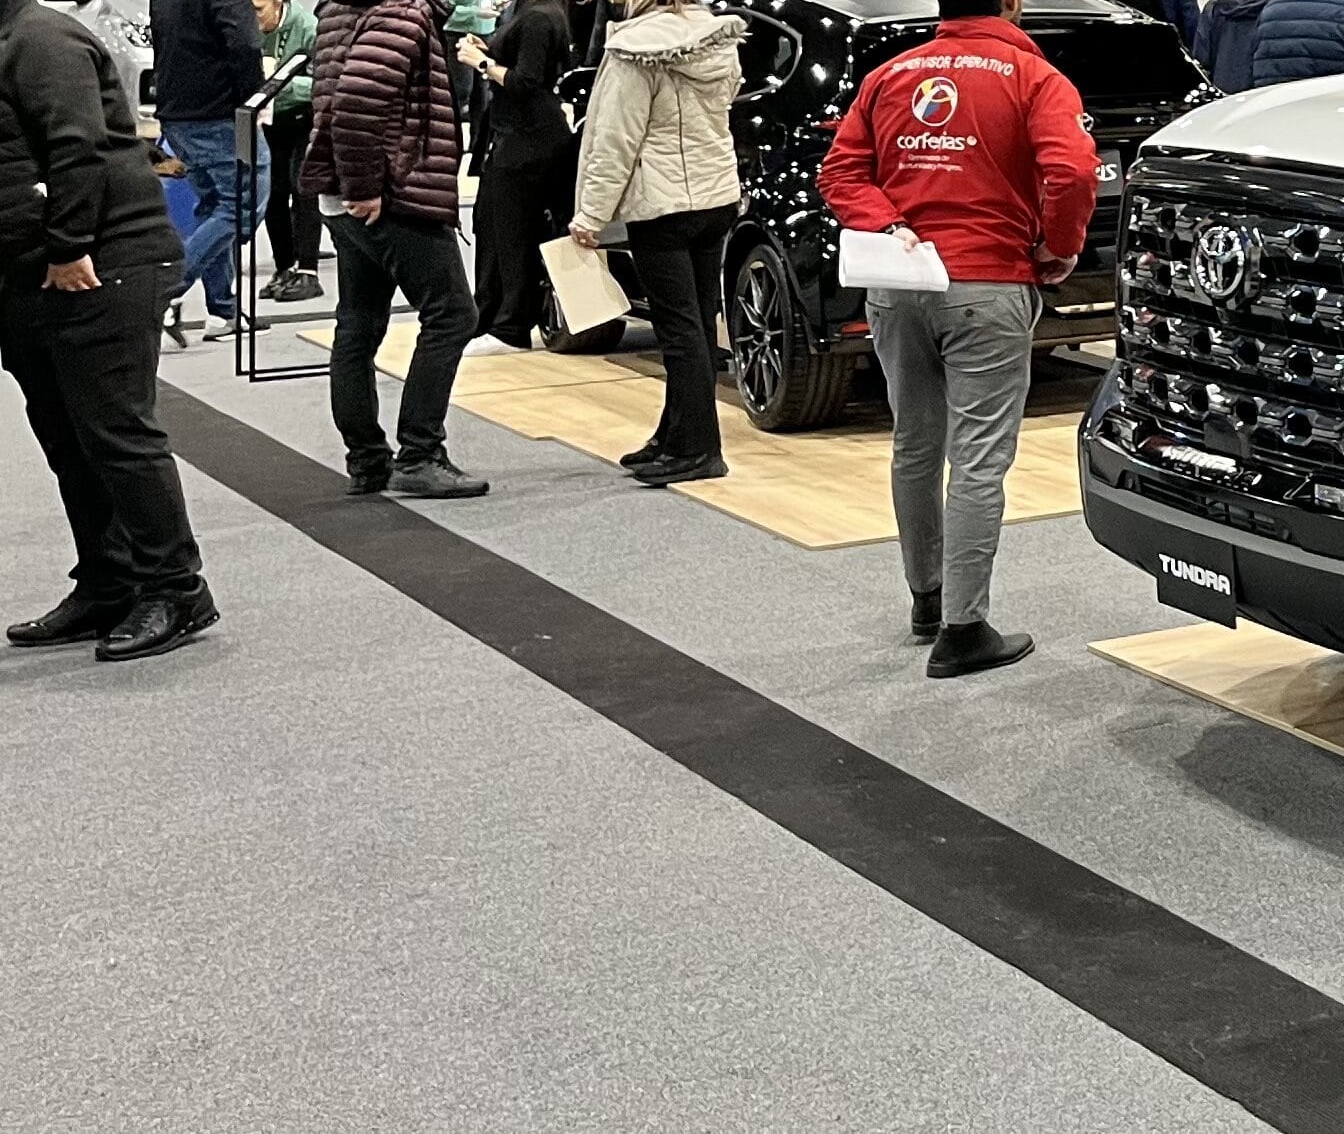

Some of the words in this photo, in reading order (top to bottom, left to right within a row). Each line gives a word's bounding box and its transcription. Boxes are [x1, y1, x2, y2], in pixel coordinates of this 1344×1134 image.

[891, 56, 952, 72] SUPERVISOR
[953, 56, 1015, 76] OPERATIVO
[896, 131, 966, 151] corferias
[1158, 553, 1231, 596] TUNDRA
